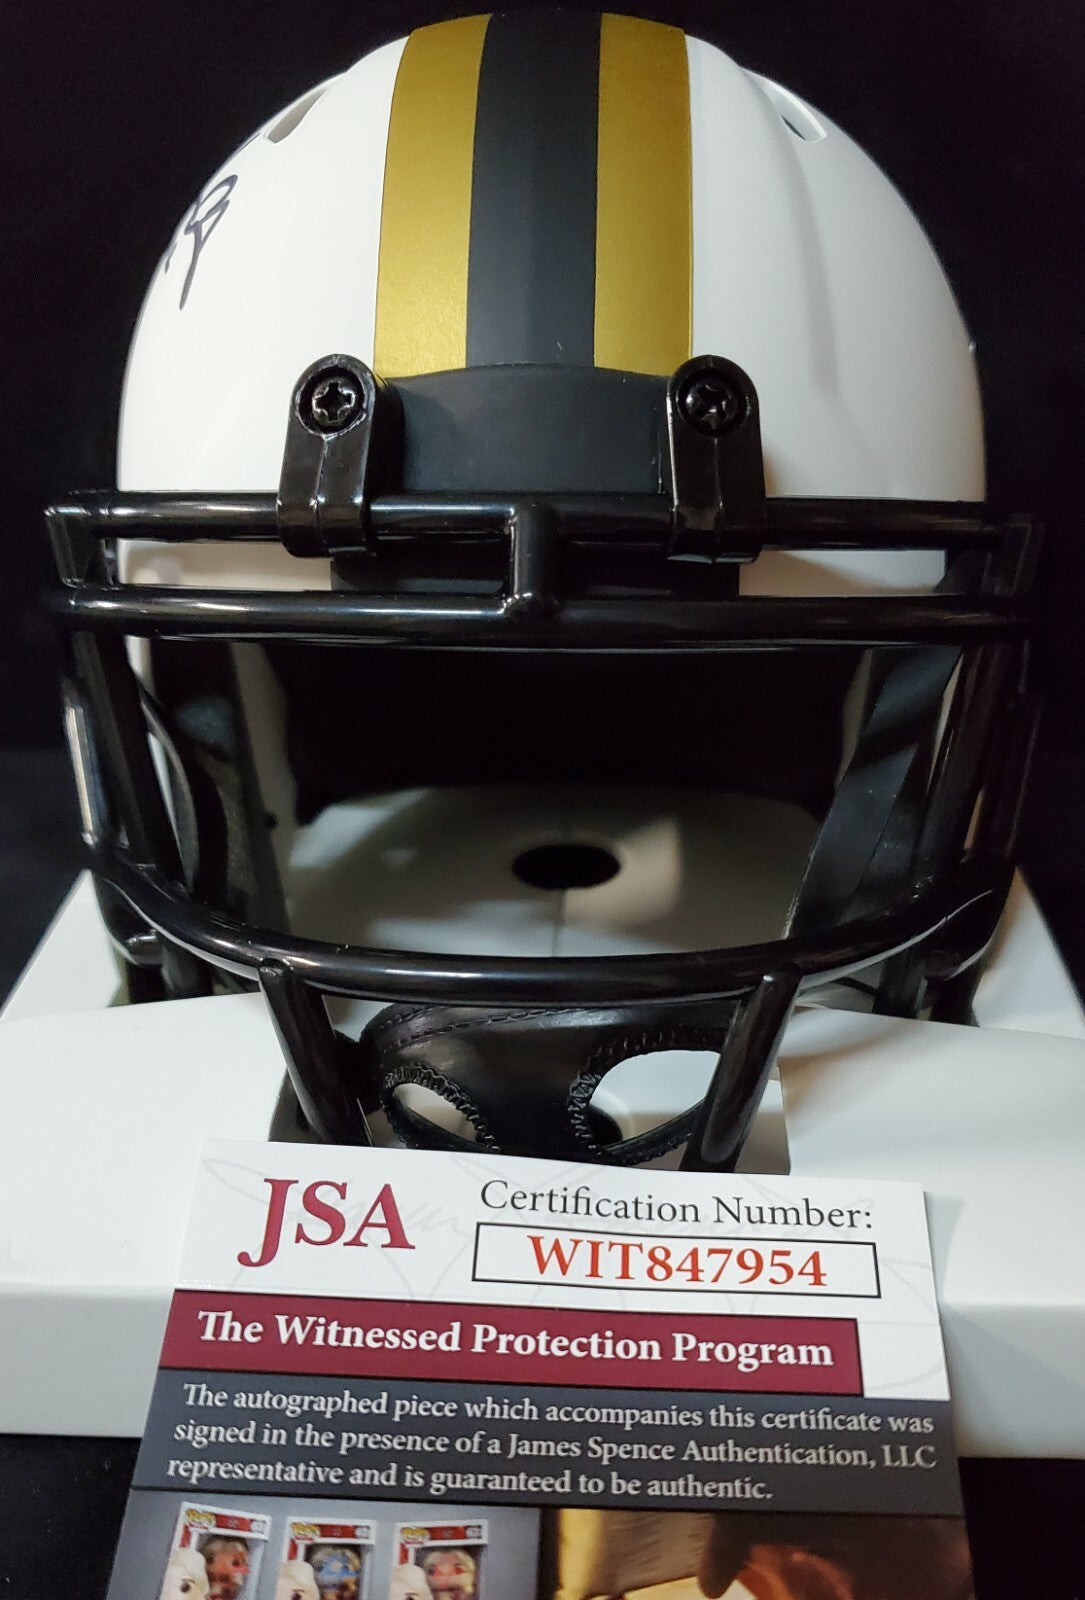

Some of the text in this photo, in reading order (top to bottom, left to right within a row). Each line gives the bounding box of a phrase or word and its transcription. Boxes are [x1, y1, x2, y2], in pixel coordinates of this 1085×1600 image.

[237, 1177, 416, 1267] JSA
[480, 1180, 872, 1228] Certification Number:
[527, 1235, 827, 1287] WIT847954
[198, 1310, 834, 1372] The Witnessed Protection Program
[183, 1383, 934, 1434] The autographed piece which accompanies this certificate was
[174, 1420, 937, 1469] signed in the presence of a James Spence Authentication, LLC
[167, 1460, 773, 1500] representative and is guaranteed to be authentic.
